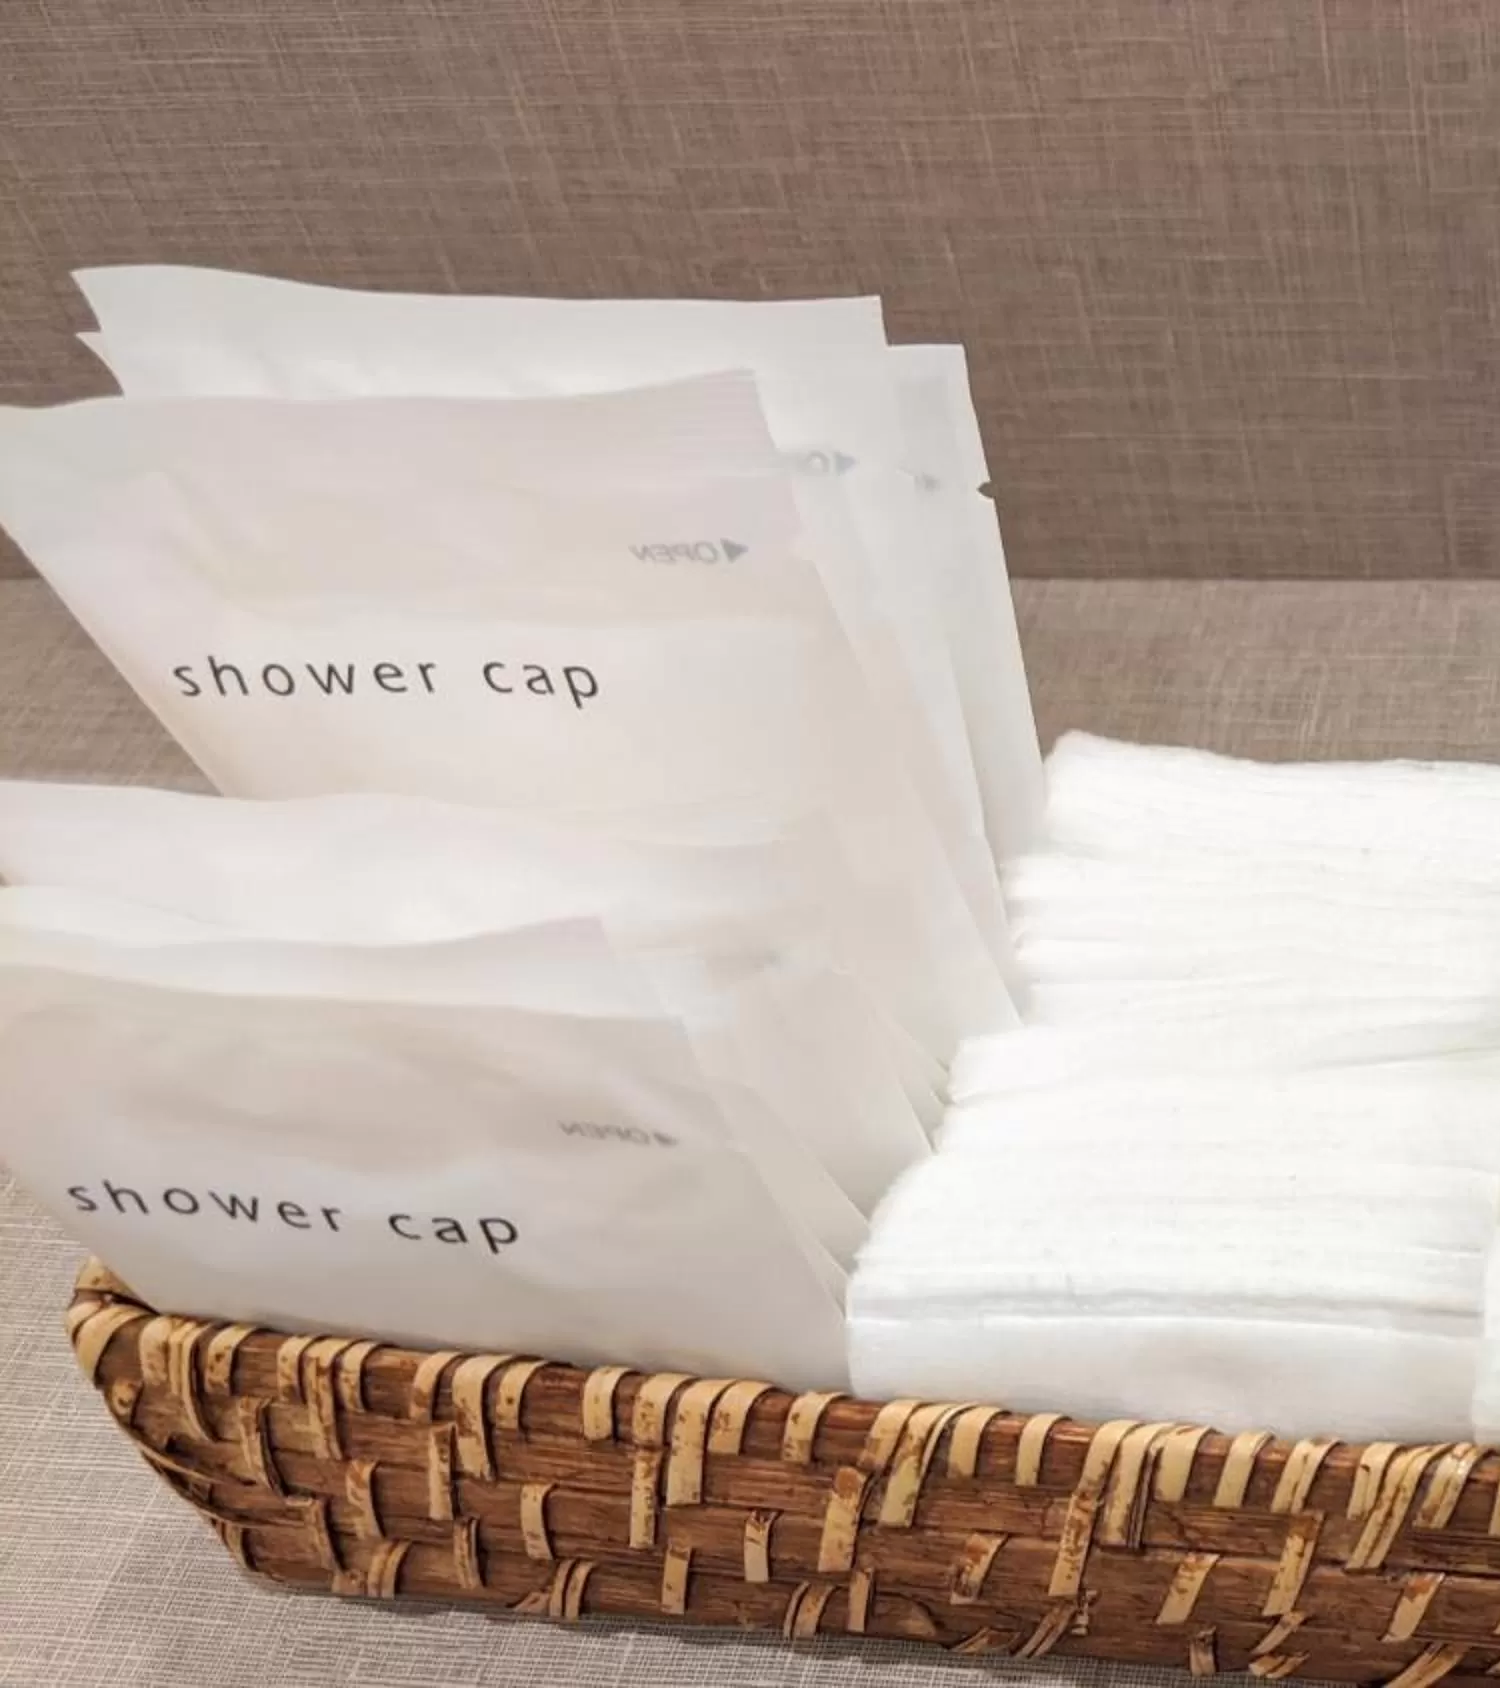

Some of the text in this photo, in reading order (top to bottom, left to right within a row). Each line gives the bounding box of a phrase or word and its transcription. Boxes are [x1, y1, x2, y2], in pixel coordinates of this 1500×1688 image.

[172, 655, 599, 710] shower cap
[66, 1179, 519, 1255] shower cap
